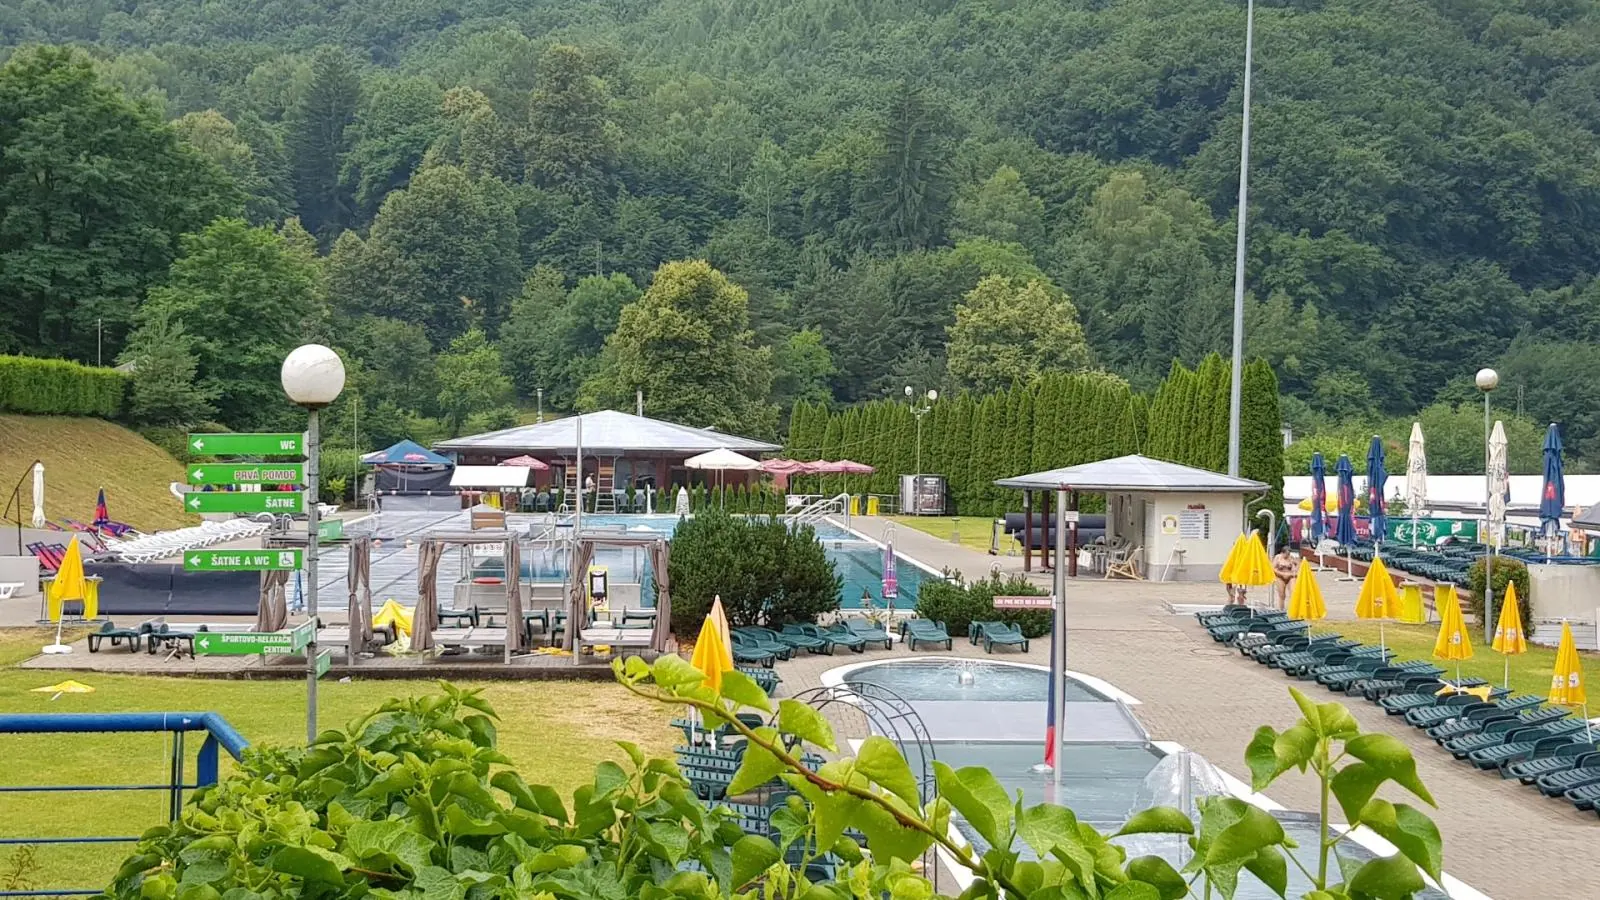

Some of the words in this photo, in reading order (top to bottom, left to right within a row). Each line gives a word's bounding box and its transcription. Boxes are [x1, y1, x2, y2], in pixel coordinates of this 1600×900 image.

[280, 440, 295, 450] WC
[234, 467, 260, 481] PRVÁ
[261, 469, 296, 481] POMOC
[265, 496, 295, 508] ŠATNE
[211, 553, 240, 566] ŠATNE
[244, 556, 251, 566] A
[254, 556, 270, 566] WC
[221, 633, 292, 643] ŠPORTOVO-RELAXAČN
